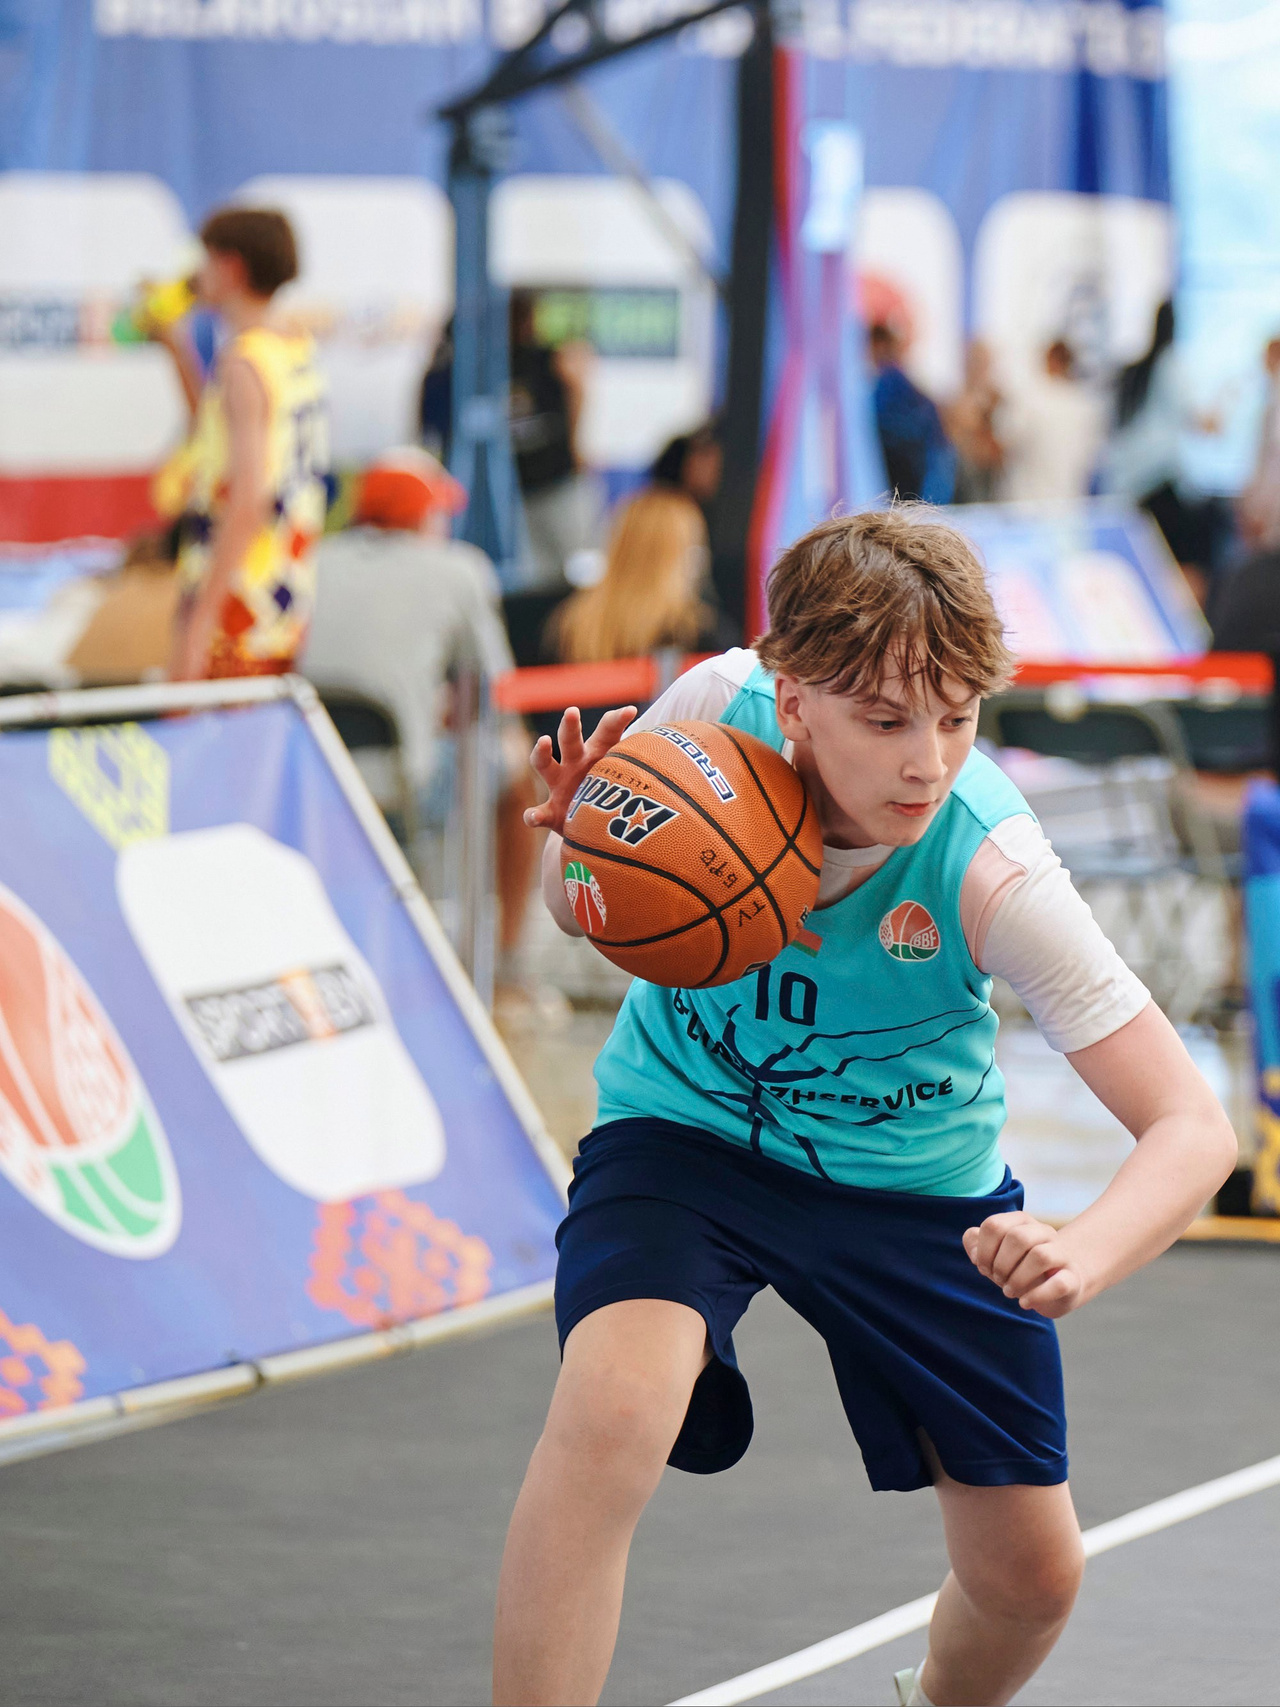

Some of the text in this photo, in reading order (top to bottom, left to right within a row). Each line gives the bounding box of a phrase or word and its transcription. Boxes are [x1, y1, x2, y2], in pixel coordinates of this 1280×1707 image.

[738, 900, 767, 928] TV
[912, 927, 938, 949] BBF
[754, 962, 819, 1027] 10
